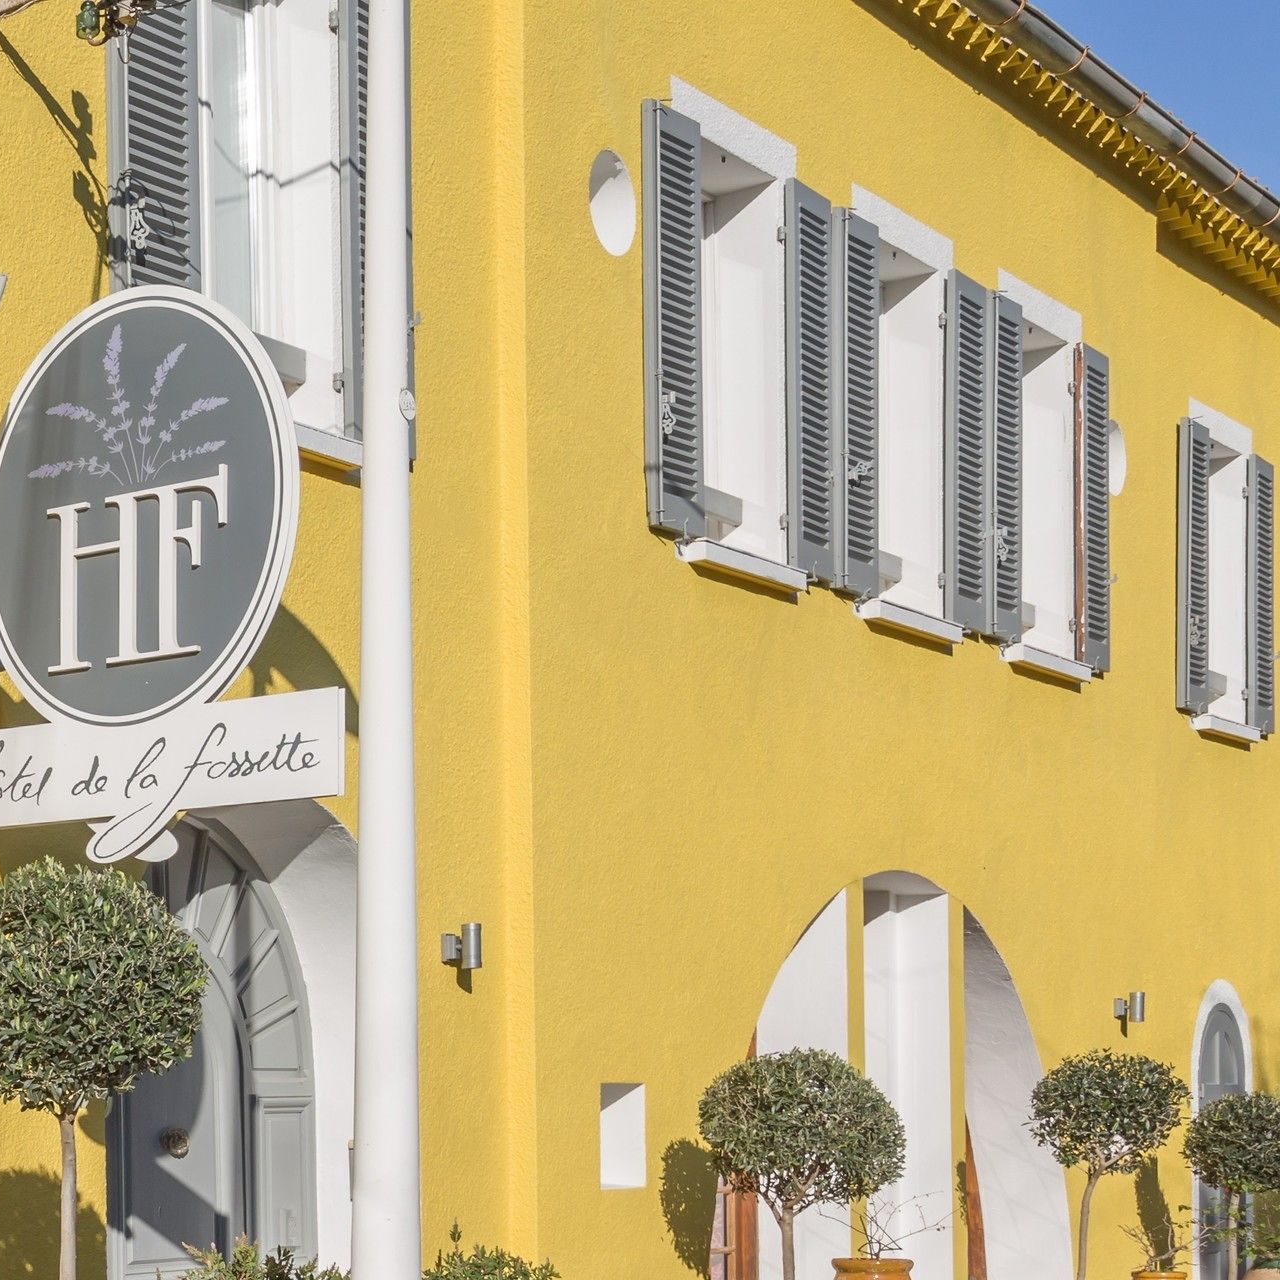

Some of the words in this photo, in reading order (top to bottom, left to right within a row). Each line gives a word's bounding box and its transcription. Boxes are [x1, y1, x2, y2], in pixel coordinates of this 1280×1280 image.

[46, 463, 228, 676] HF
[71, 756, 108, 797] de
[93, 722, 320, 859] fossette
[124, 737, 166, 799] la
